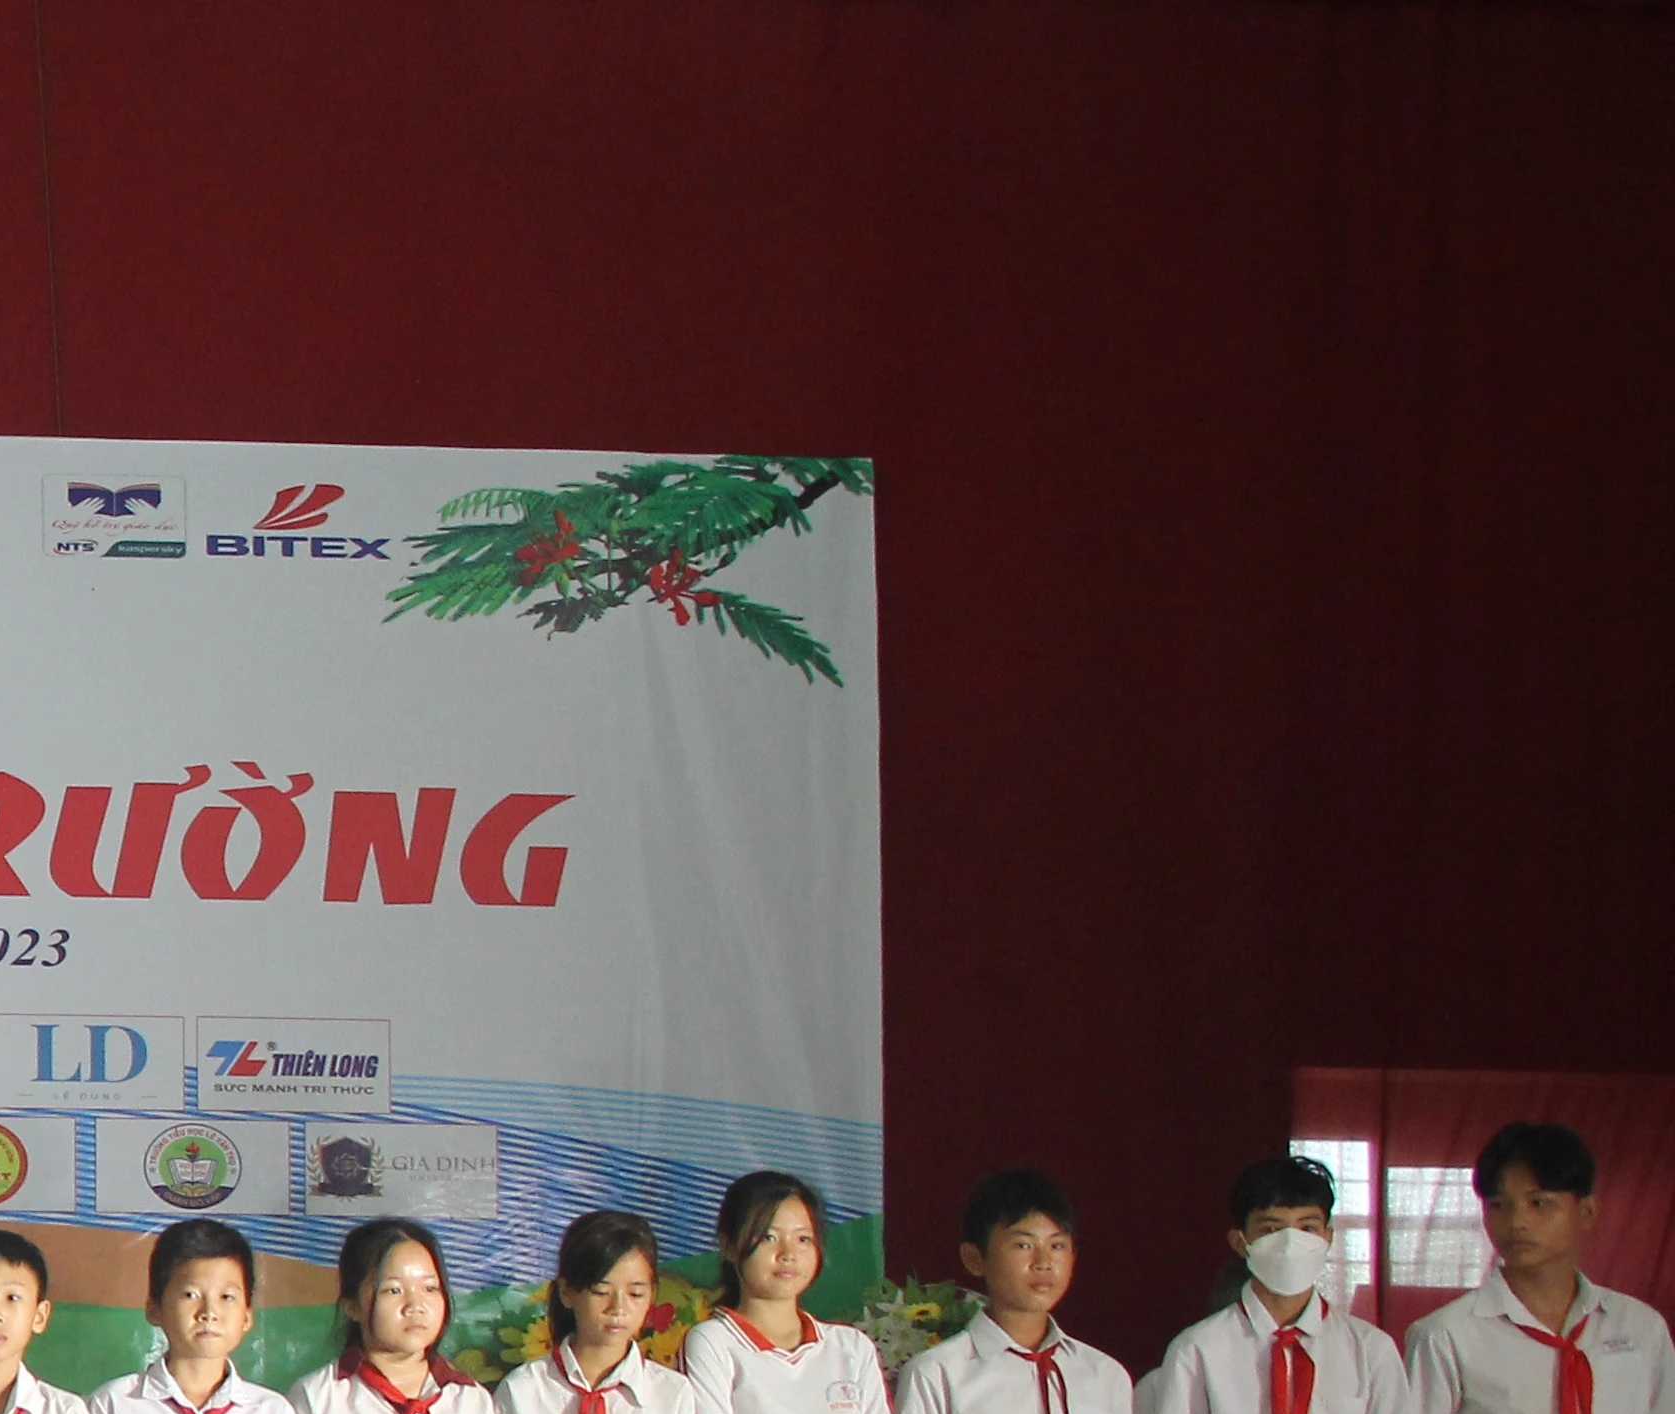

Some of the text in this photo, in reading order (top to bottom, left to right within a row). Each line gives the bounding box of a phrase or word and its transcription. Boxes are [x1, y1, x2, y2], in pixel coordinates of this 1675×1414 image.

[57, 543, 95, 551] NTS
[206, 534, 391, 560] BITEX
[30, 1024, 147, 1082] LD
[271, 1050, 379, 1078] THIÊN LONG
[214, 1084, 247, 1092] SỨC
[302, 1085, 326, 1093] TRI
[331, 1086, 374, 1094] THỨC
